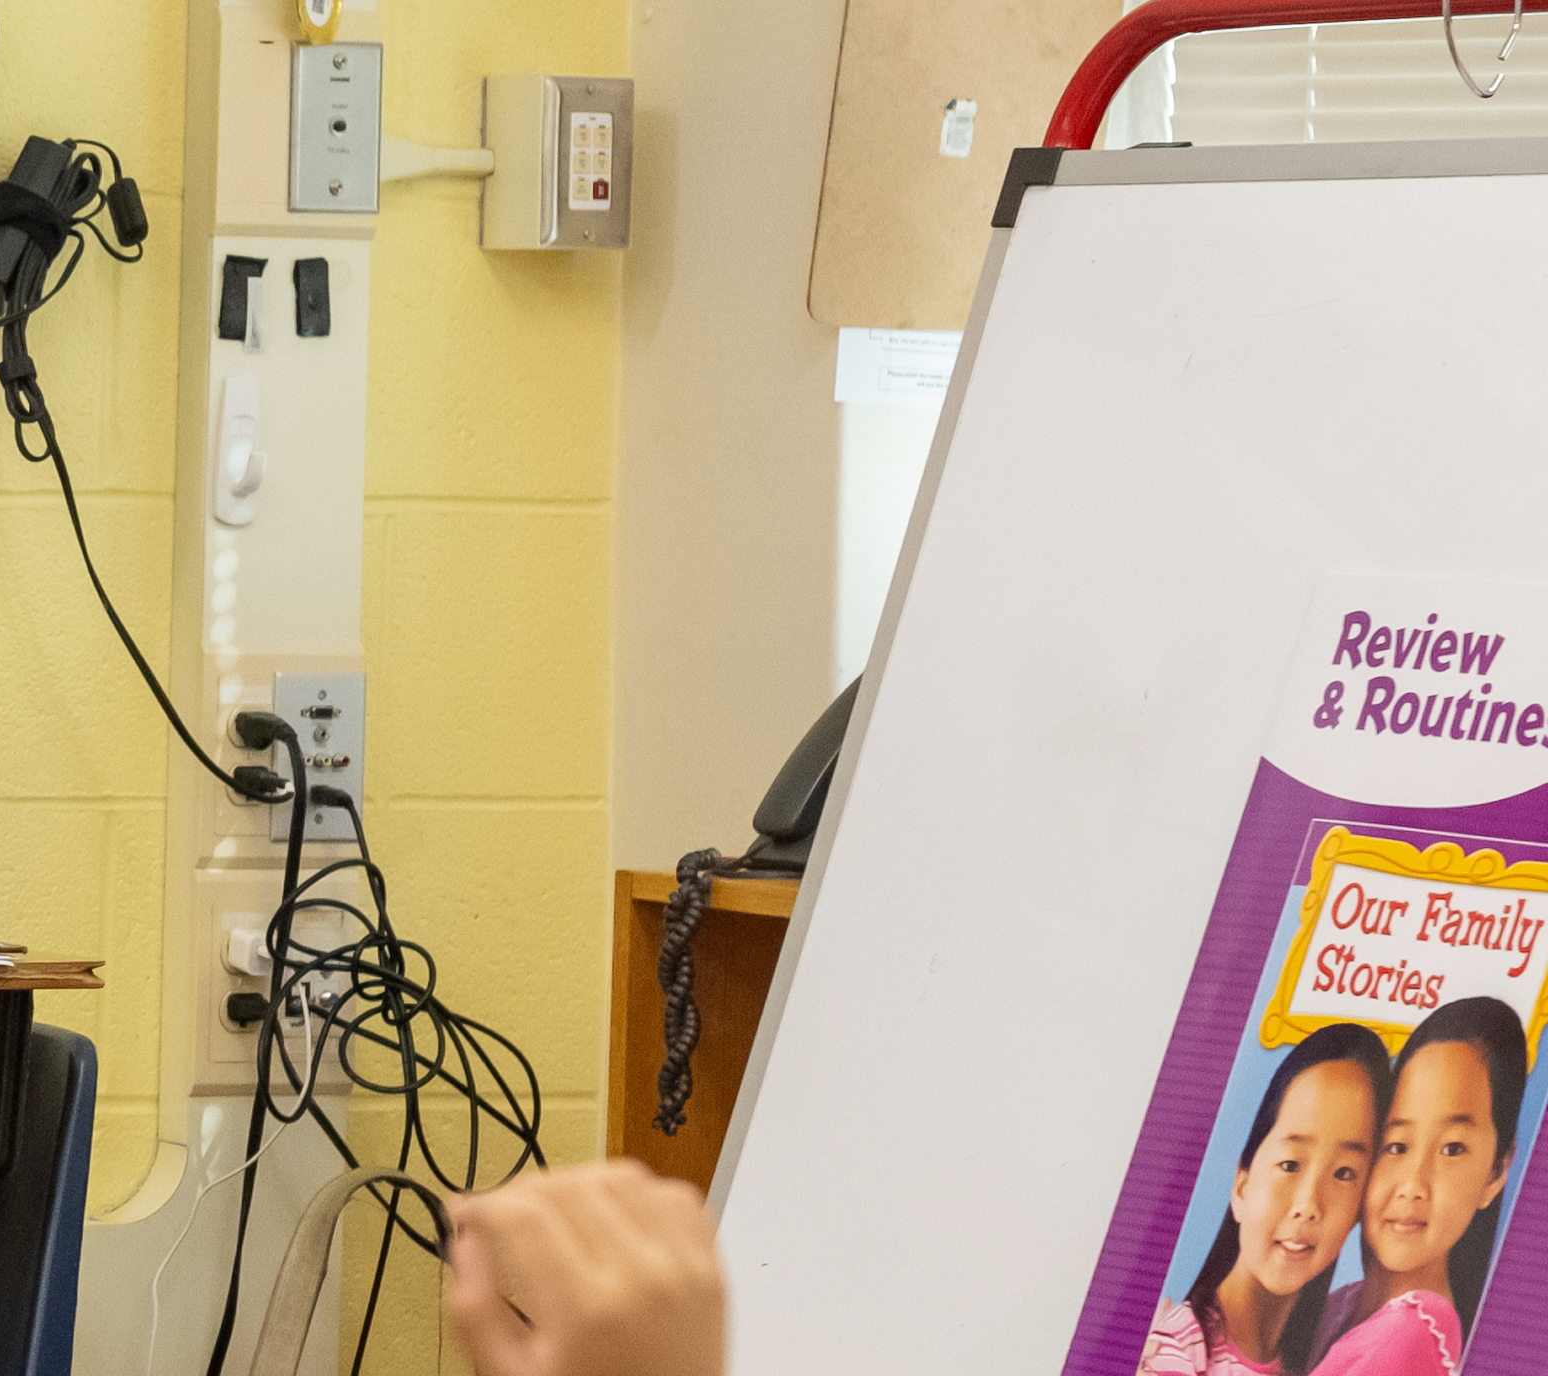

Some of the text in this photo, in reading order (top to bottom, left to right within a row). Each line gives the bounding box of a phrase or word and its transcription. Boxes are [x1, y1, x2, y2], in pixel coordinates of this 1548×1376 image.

[1331, 609, 1506, 676] Review
[1312, 679, 1345, 730] &
[1330, 881, 1545, 979] Our Family
[1312, 942, 1445, 1010] Stories
